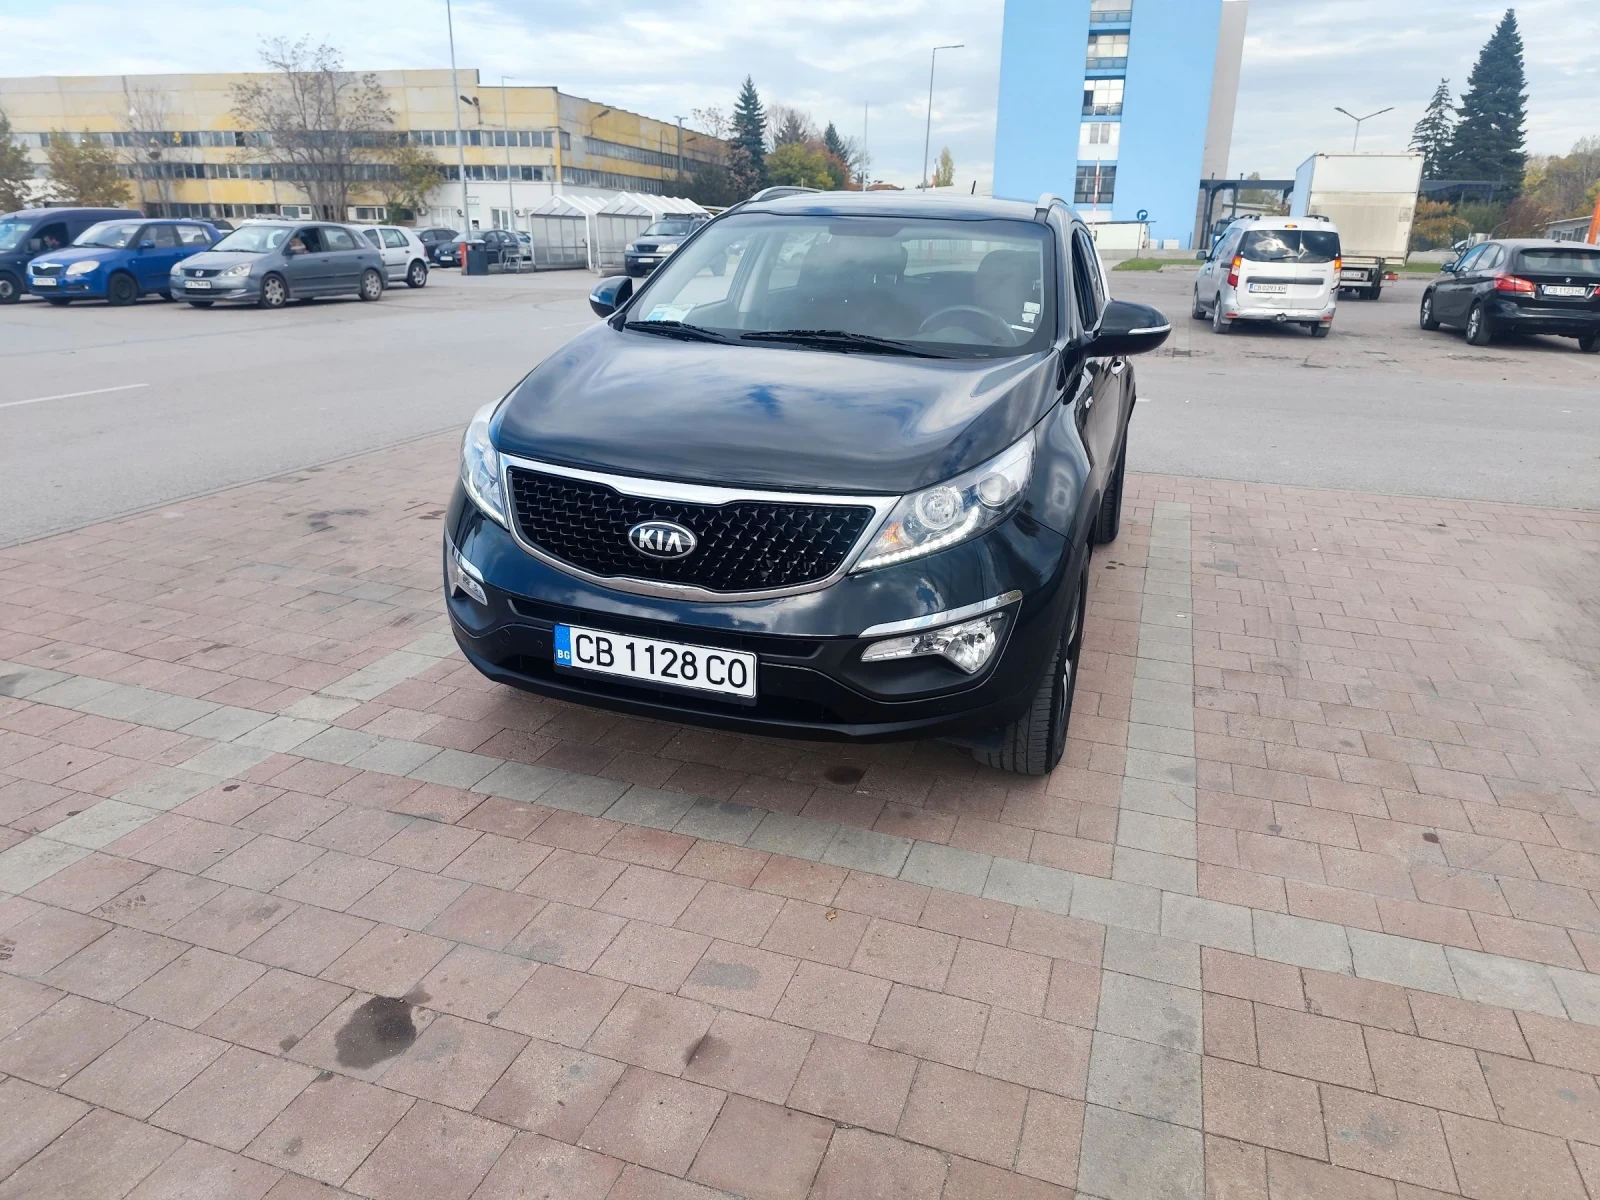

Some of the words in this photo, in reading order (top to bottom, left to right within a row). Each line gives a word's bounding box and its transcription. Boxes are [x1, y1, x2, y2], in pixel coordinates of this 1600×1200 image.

[638, 528, 683, 553] KIA
[557, 649, 571, 660] BG
[575, 633, 615, 667] CB
[625, 642, 698, 681] 1128
